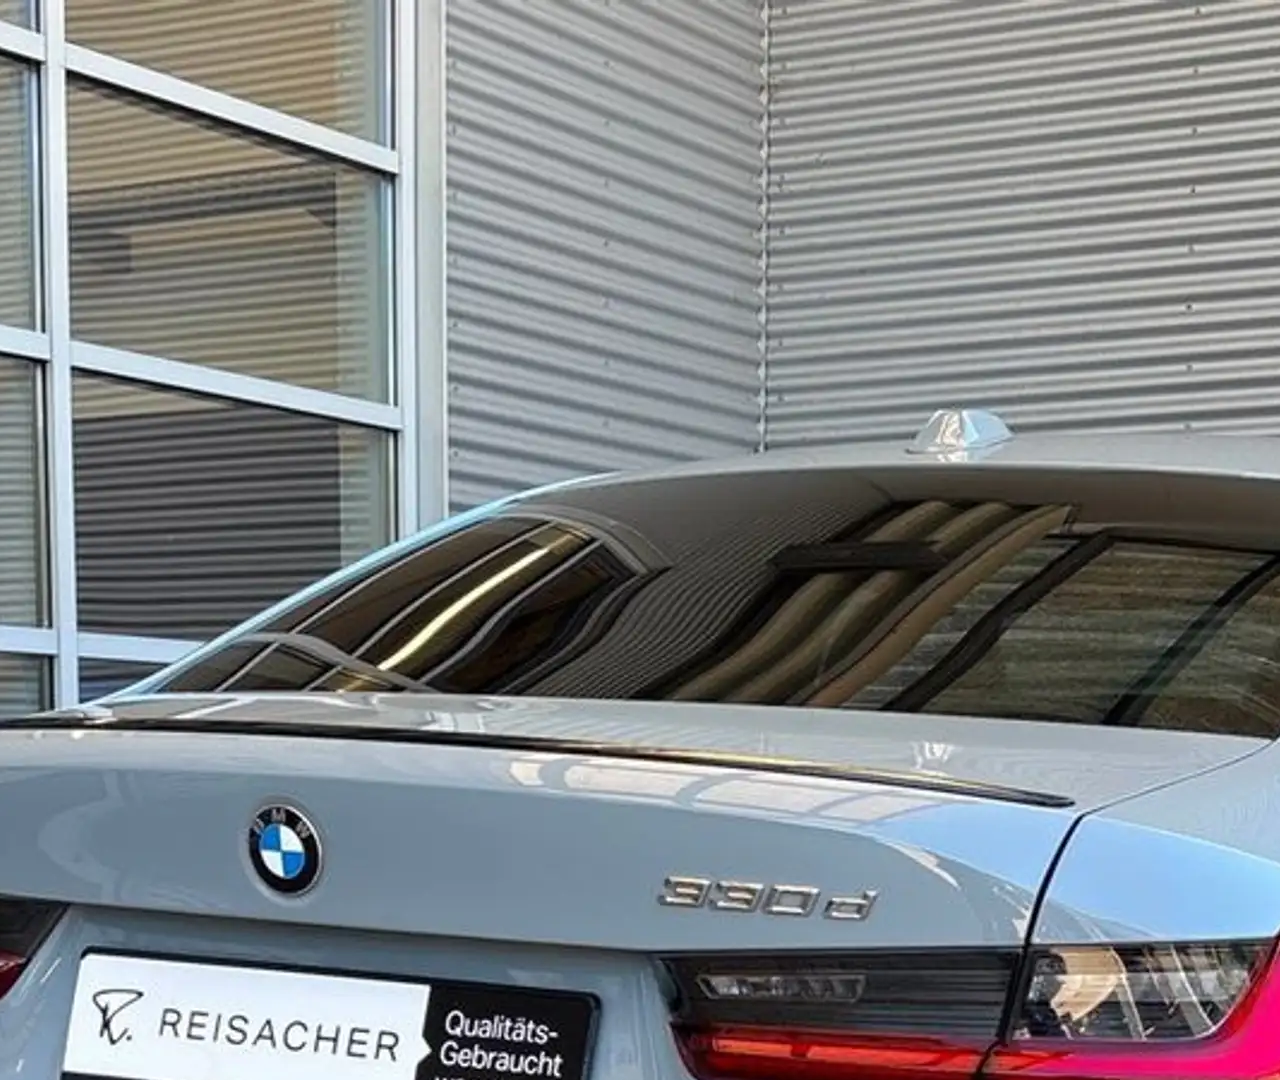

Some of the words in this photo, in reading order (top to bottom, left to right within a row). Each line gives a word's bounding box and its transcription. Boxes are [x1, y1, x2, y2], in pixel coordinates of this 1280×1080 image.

[658, 876, 880, 921] 330d
[159, 1007, 401, 1062] REISACHER
[445, 1010, 559, 1045] Qualitäts-
[440, 1040, 563, 1078] Gebraucht
